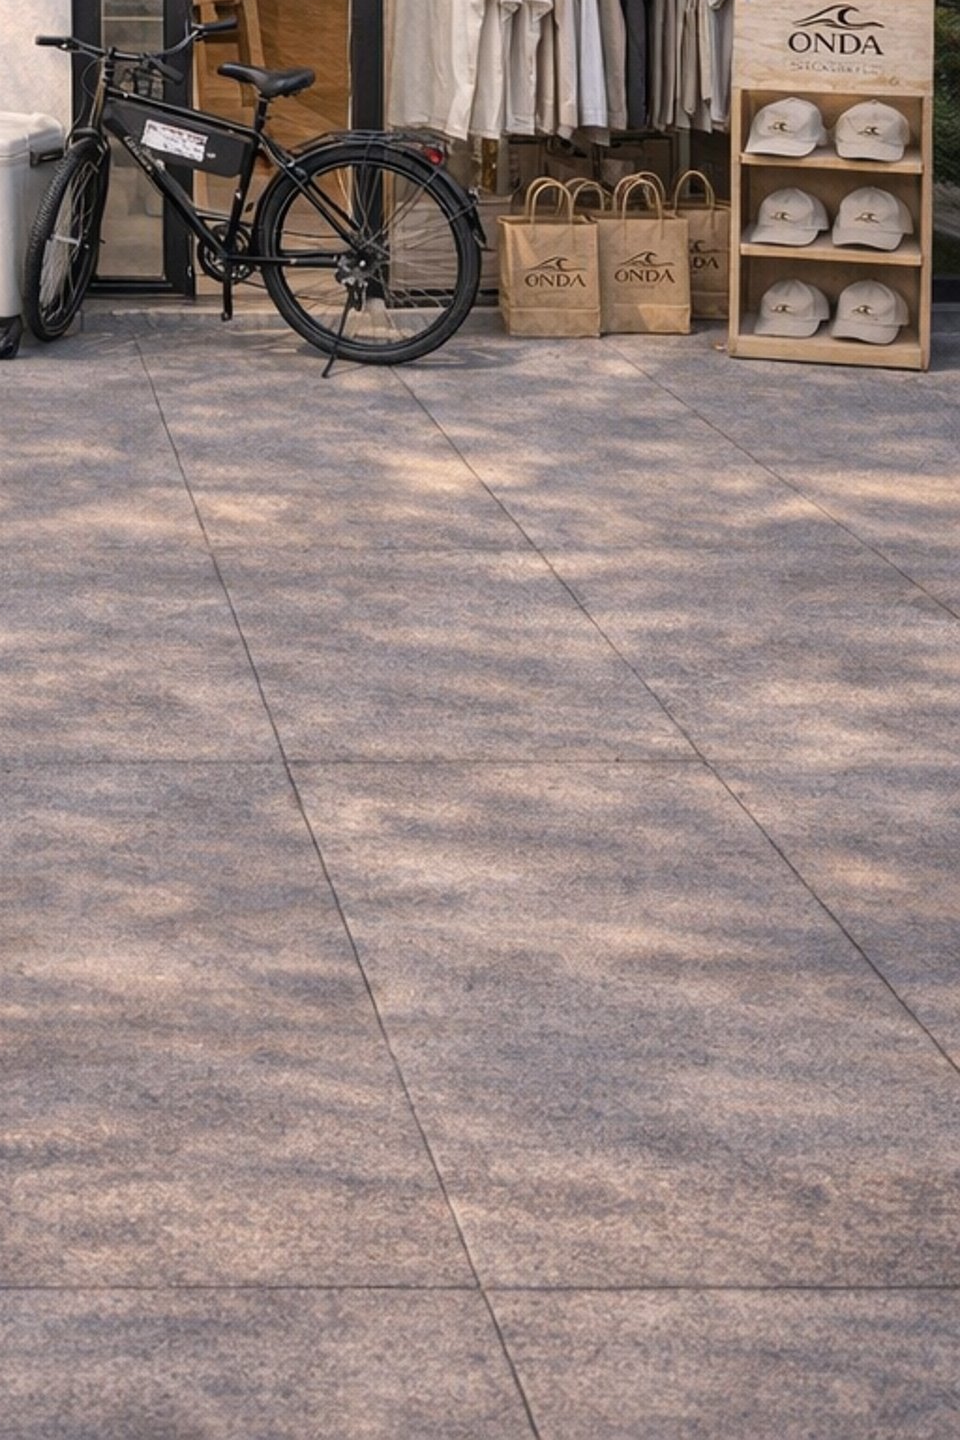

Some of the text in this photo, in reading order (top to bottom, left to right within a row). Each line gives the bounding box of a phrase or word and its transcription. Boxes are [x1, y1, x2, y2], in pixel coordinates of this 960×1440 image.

[787, 31, 884, 56] ONDA
[524, 273, 587, 288] ONDA
[614, 268, 676, 284] ONDA
